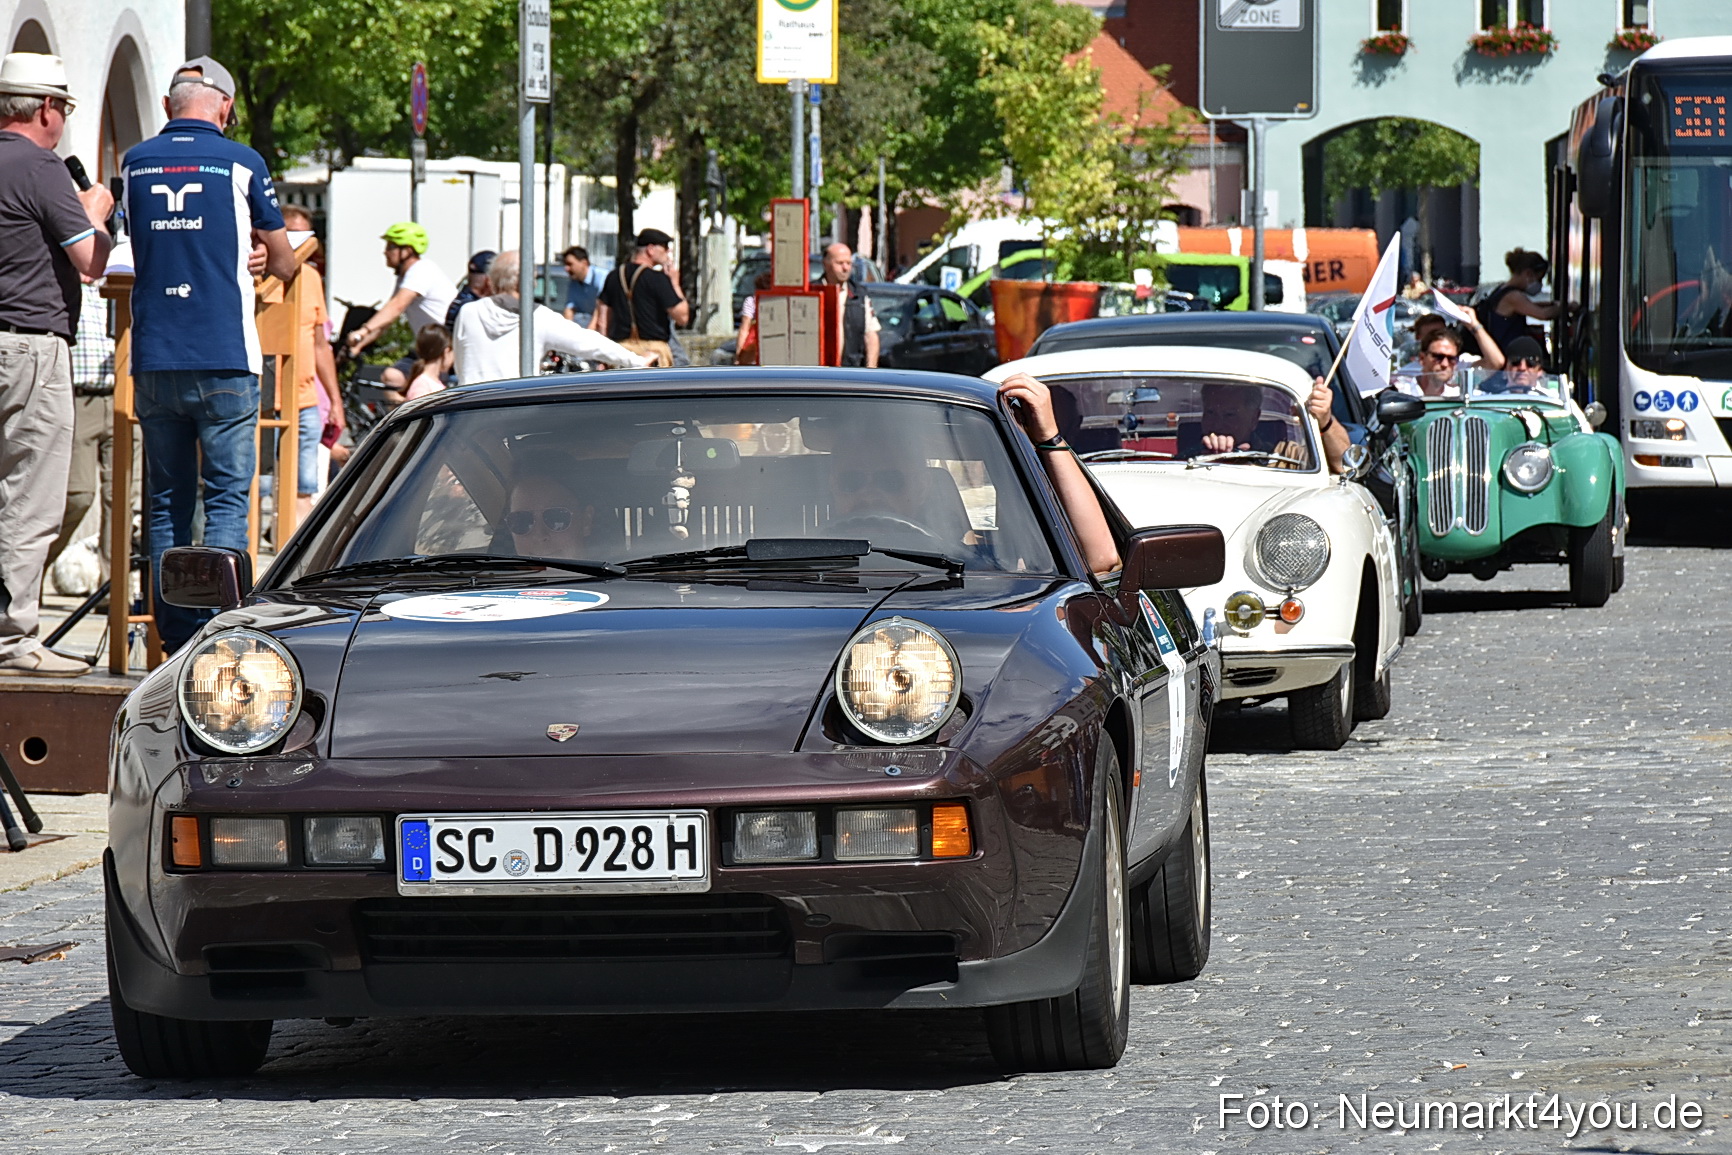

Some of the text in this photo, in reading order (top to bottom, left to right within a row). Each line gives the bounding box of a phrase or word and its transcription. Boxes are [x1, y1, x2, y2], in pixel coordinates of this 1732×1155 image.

[1240, 9, 1280, 24] ZONE
[130, 166, 163, 177] WILLIAMS
[199, 165, 230, 177] RACING
[151, 216, 203, 231] randstad
[435, 827, 497, 874] SC
[412, 857, 424, 871] D
